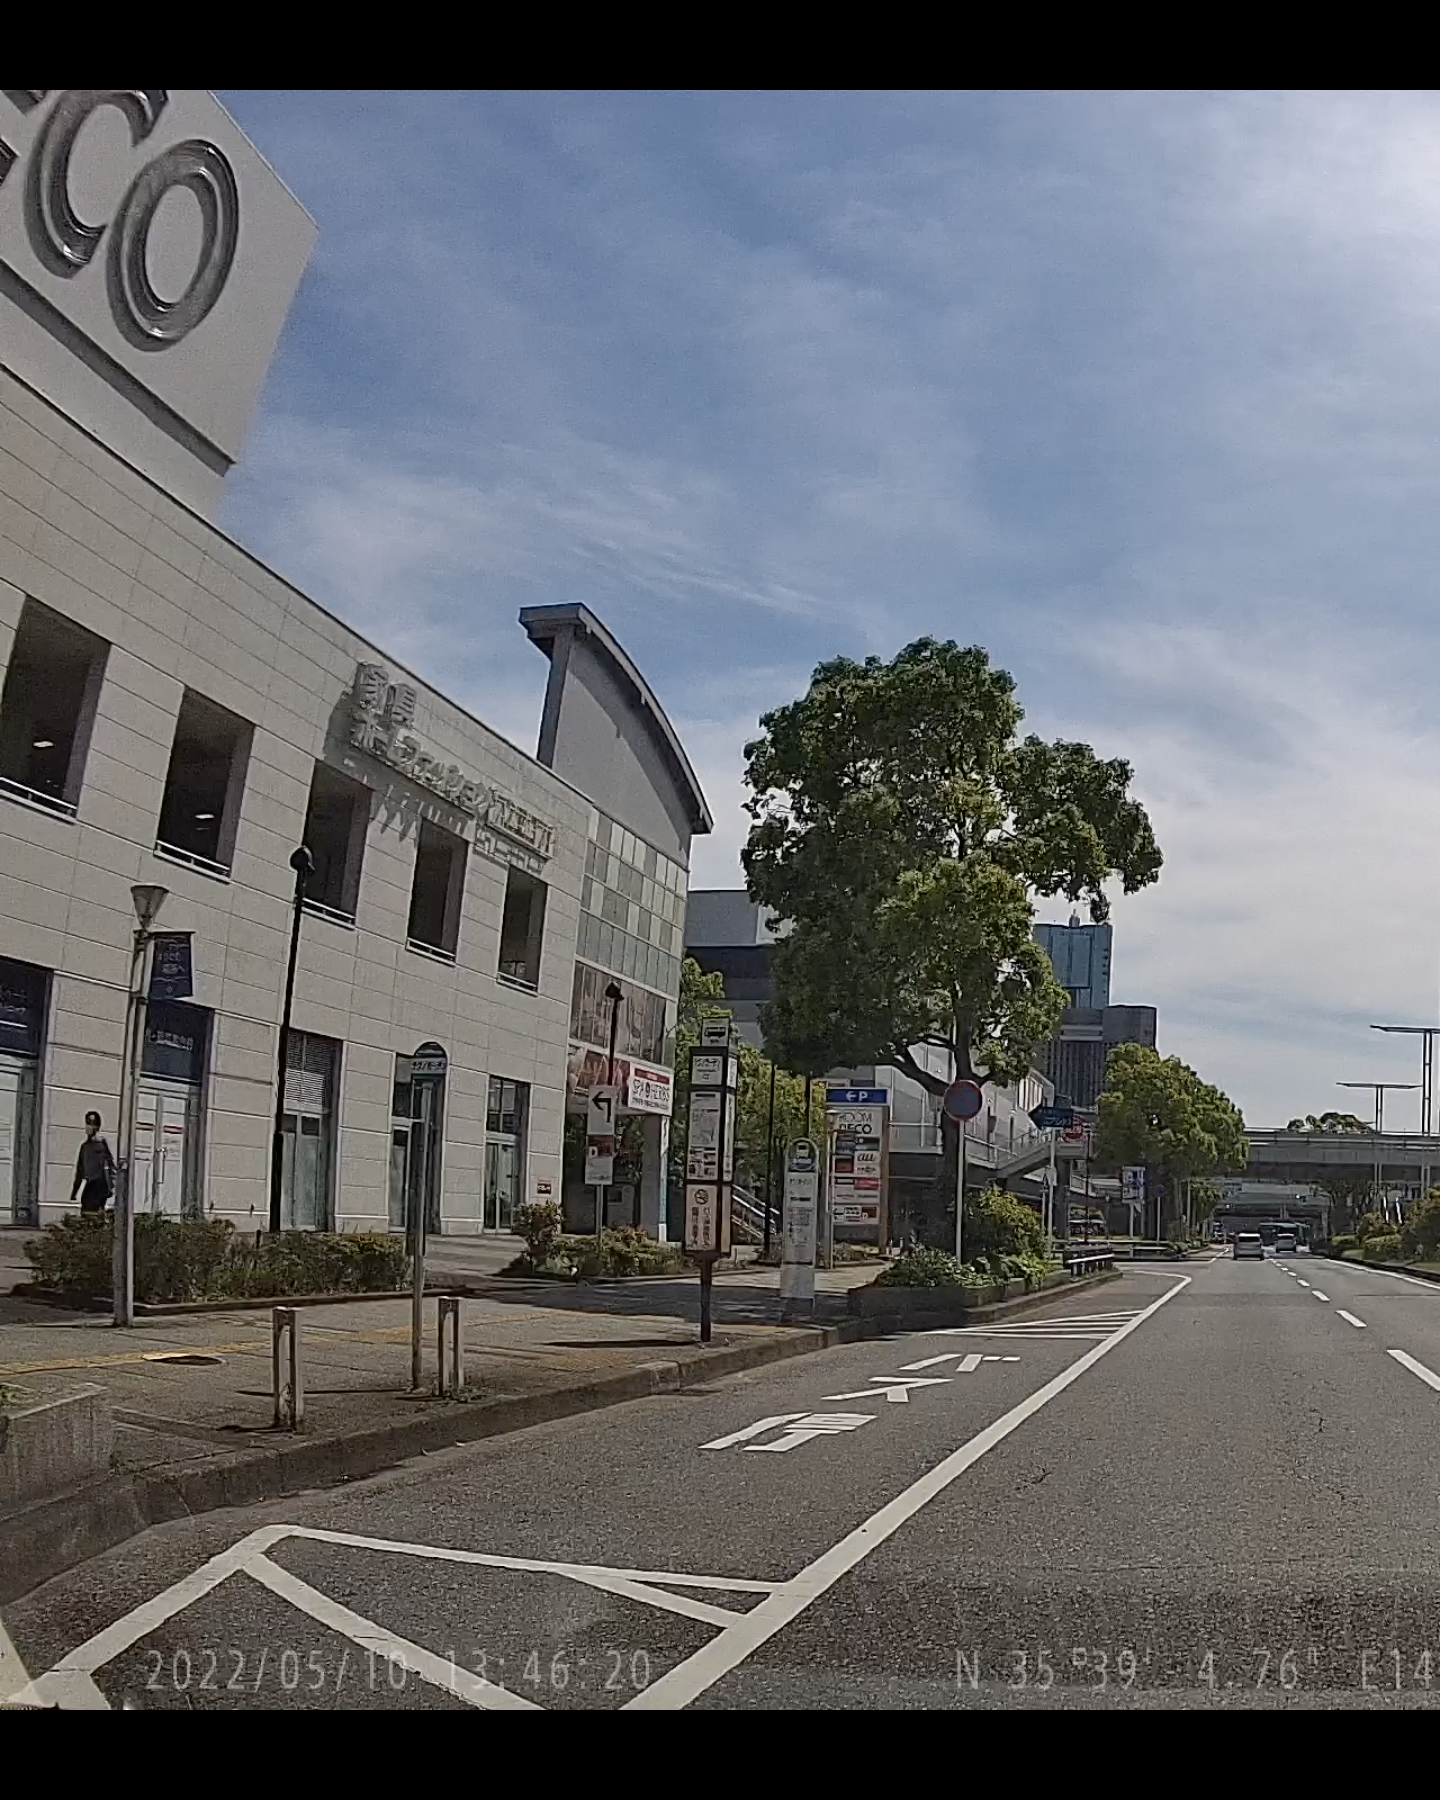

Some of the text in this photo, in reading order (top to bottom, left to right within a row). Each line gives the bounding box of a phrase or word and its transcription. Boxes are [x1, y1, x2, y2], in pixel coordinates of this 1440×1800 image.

[0, 90, 240, 352] CO
[859, 1091, 868, 1101] P
[857, 1153, 875, 1162] au
